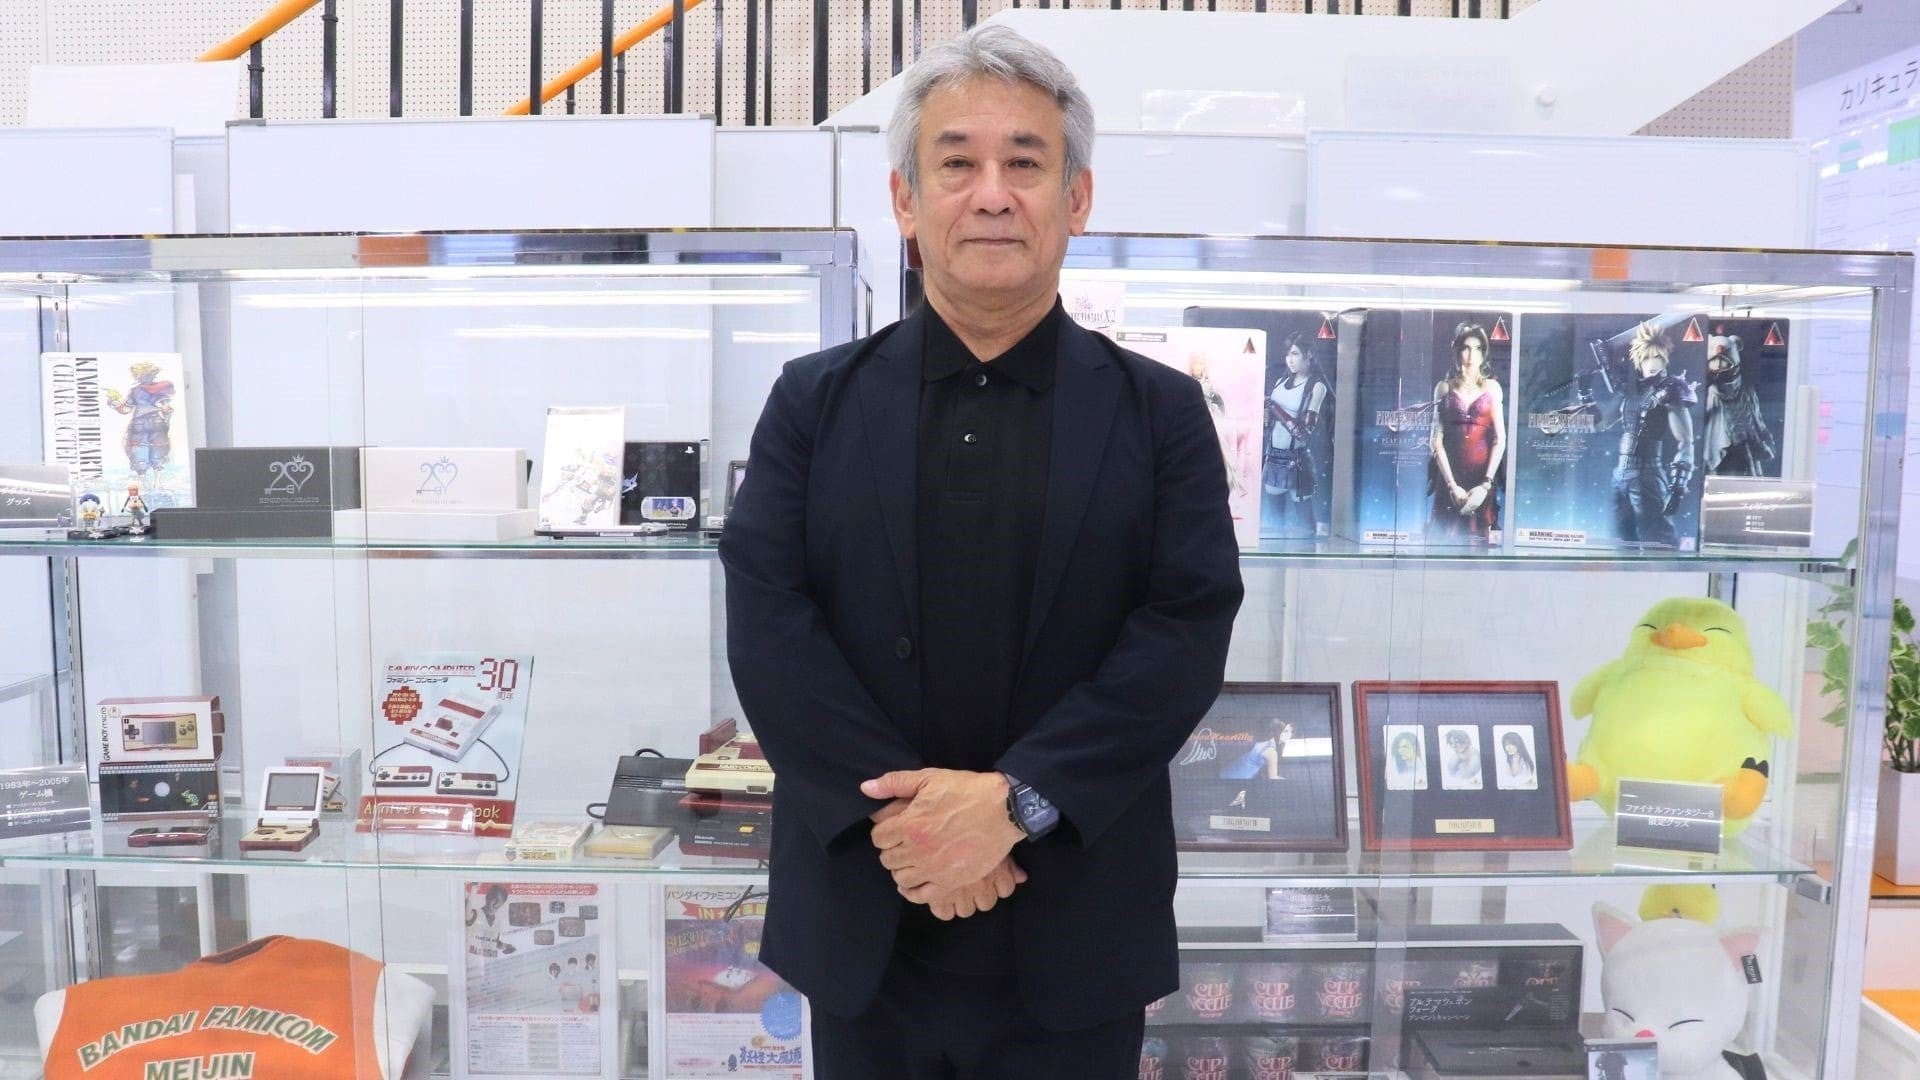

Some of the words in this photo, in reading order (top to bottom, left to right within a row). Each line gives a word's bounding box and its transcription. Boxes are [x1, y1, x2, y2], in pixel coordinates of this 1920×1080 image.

[1840, 60, 1919, 111] カリキュラ
[75, 356, 101, 418] KINGDOM
[6, 497, 31, 507] グッズ
[477, 658, 519, 692] 30
[103, 742, 111, 760] GAME
[76, 1010, 200, 1072] BANDAI
[201, 1005, 339, 1056] FAMICOM
[145, 1052, 256, 1080] MEIJIN
